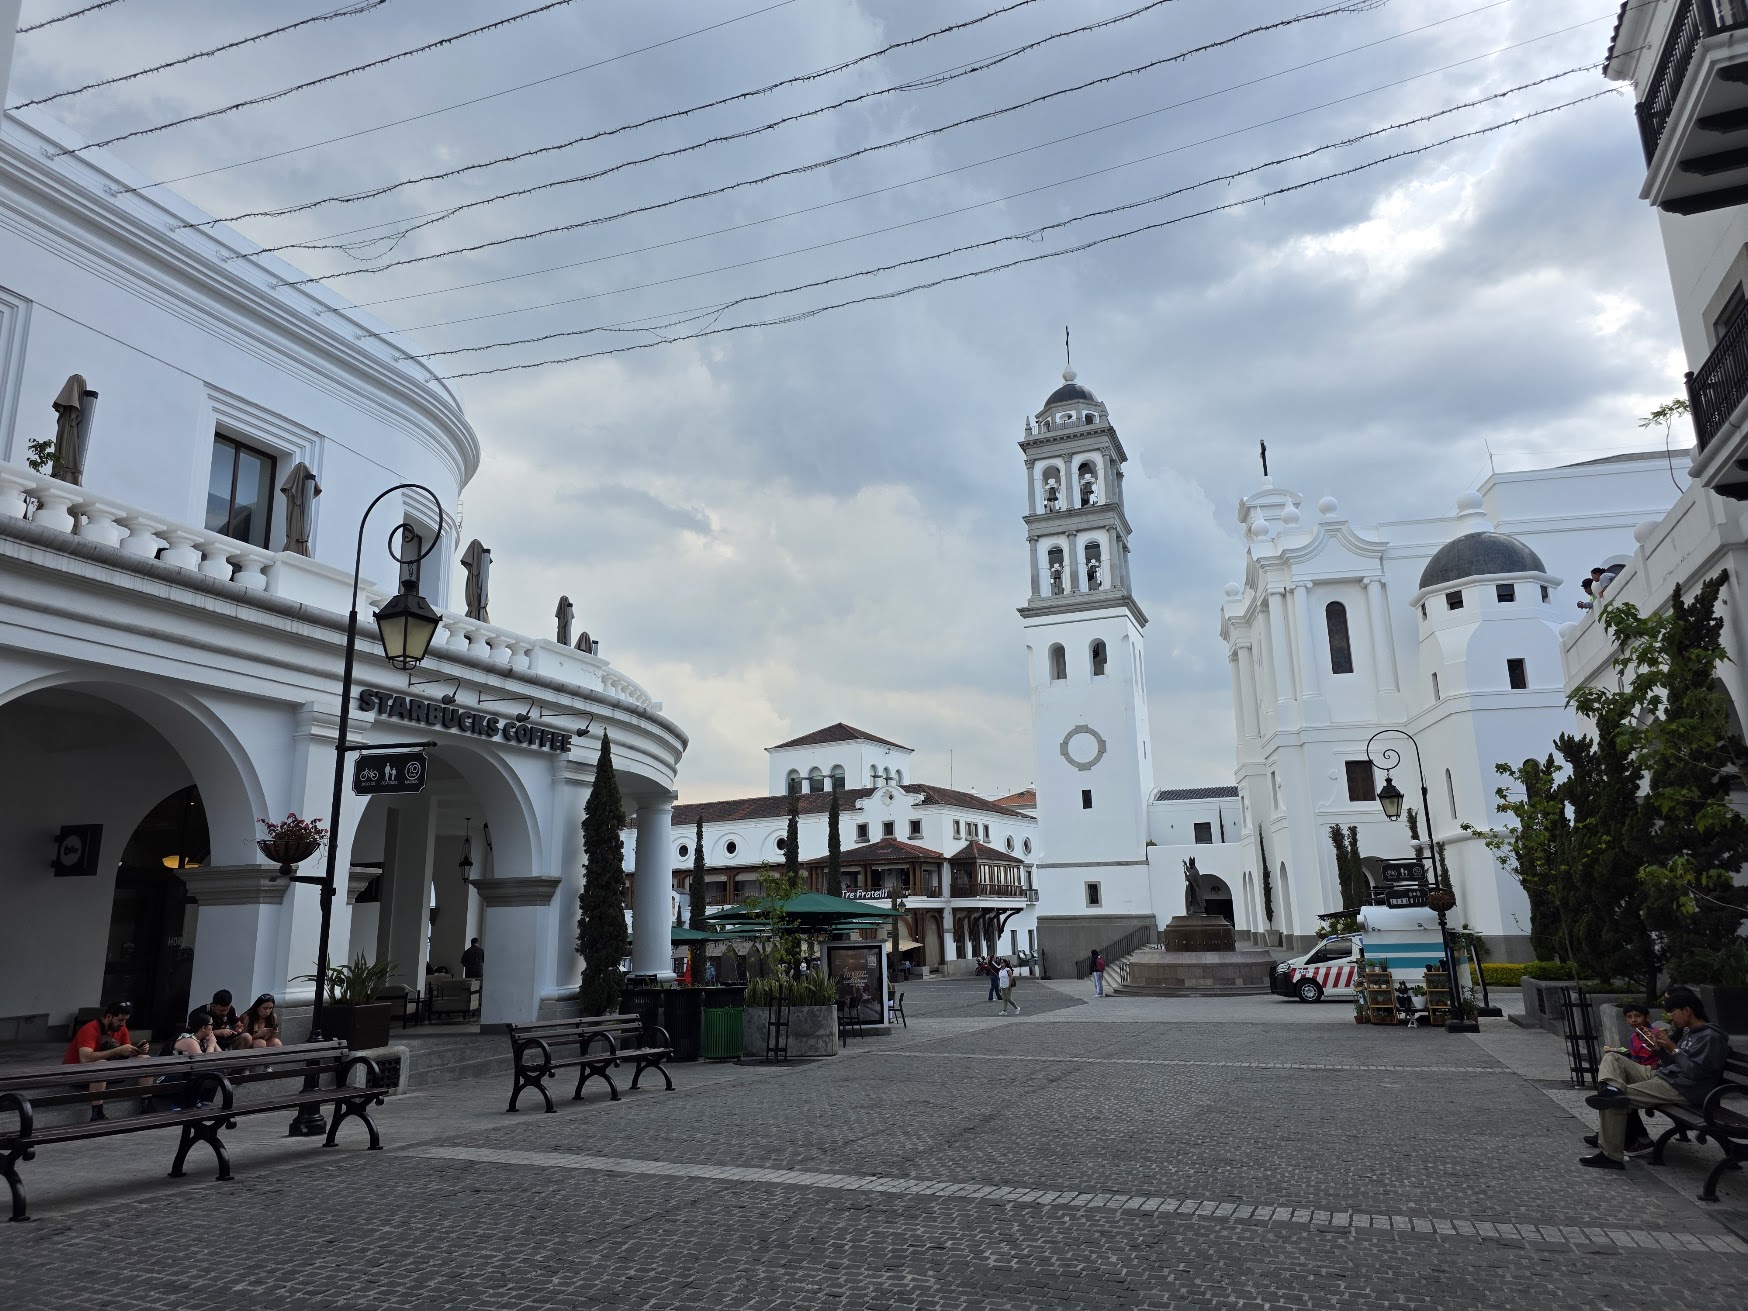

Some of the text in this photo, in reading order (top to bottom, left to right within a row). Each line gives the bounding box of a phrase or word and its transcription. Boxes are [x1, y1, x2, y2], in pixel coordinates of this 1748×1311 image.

[359, 689, 572, 752] STARBUCKS COFFEE
[408, 764, 419, 773] 10
[841, 889, 888, 899] Tre Fratelli
